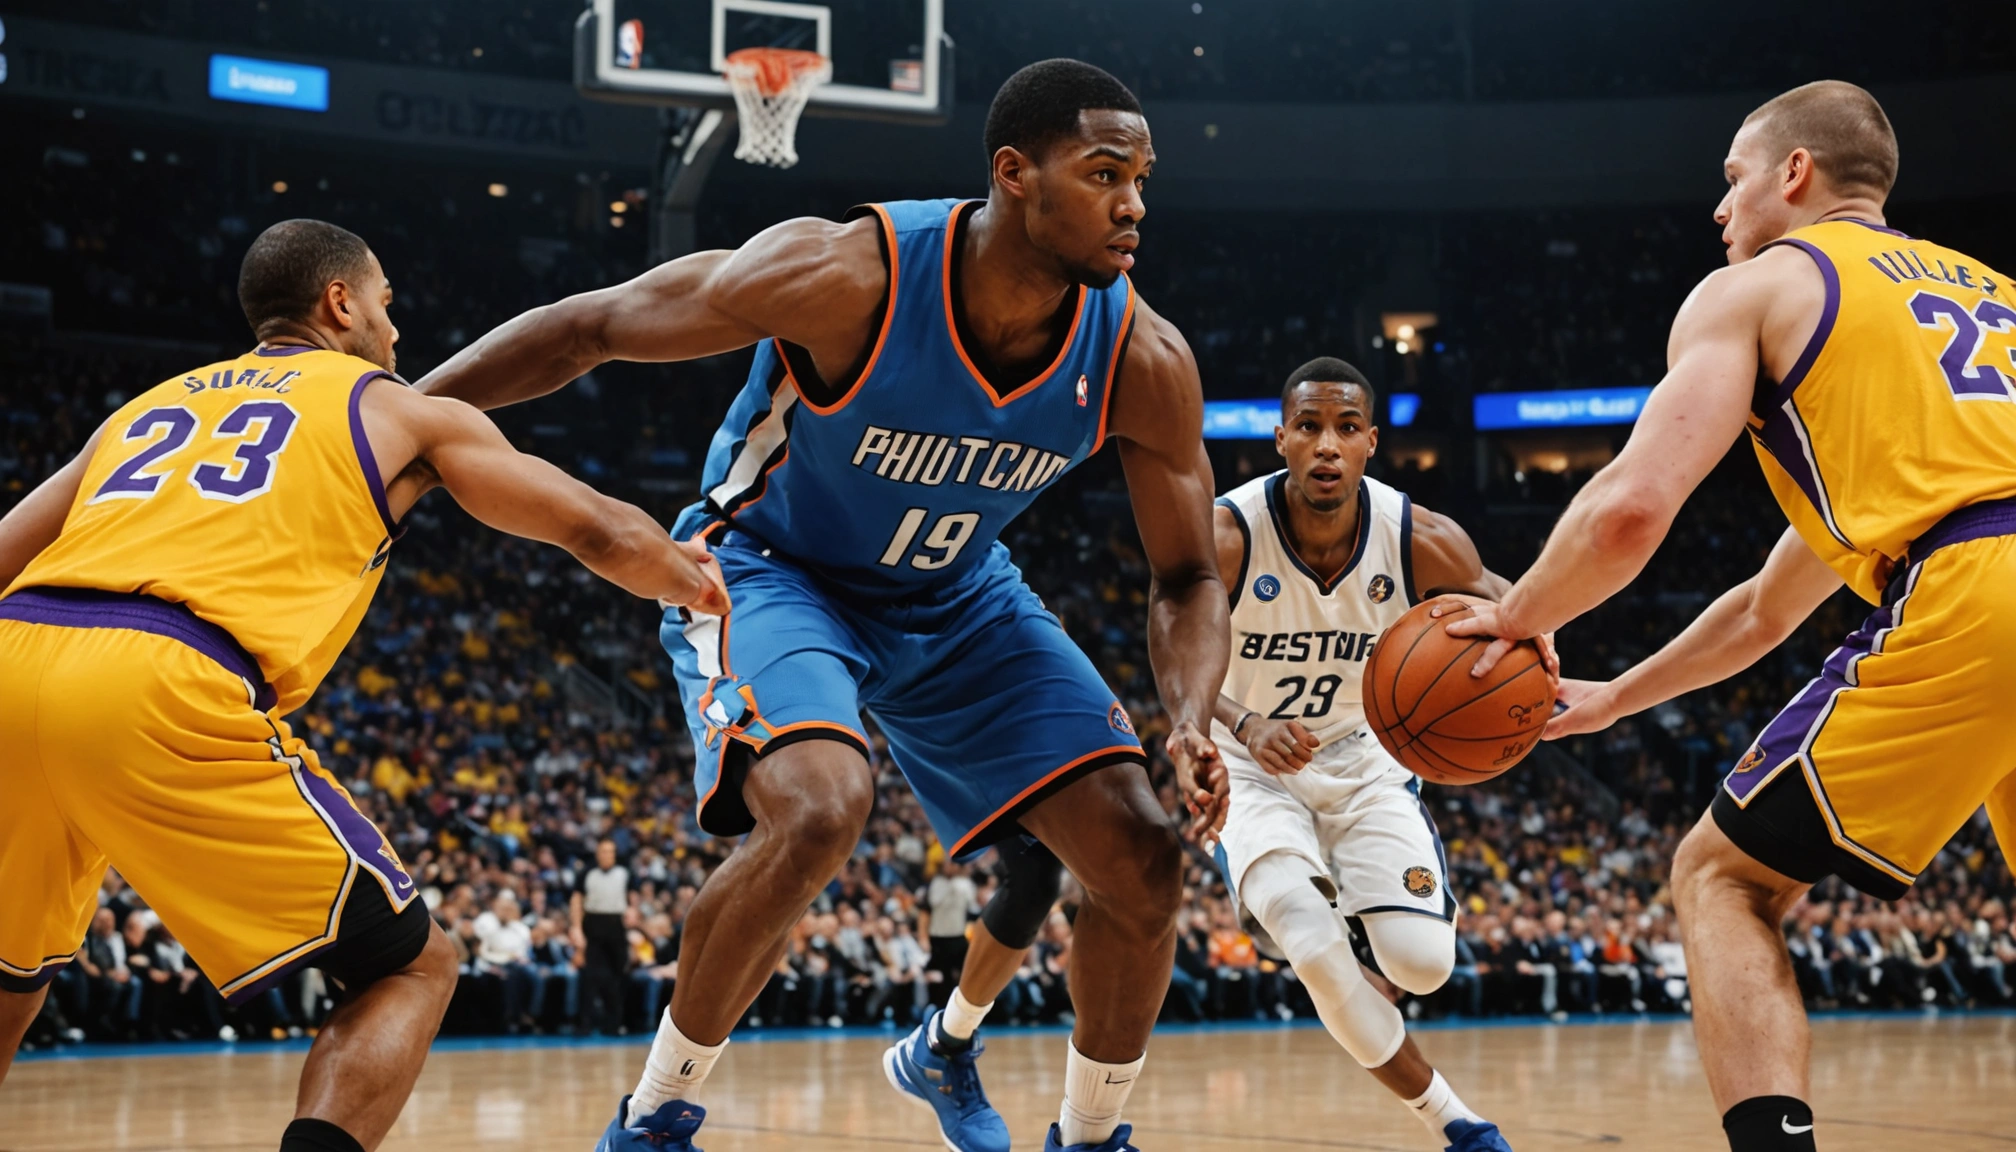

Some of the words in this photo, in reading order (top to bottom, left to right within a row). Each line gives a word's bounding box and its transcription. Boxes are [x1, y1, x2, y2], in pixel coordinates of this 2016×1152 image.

[87, 400, 301, 505] 23
[878, 506, 982, 571] 19
[1268, 674, 1343, 720] 29
